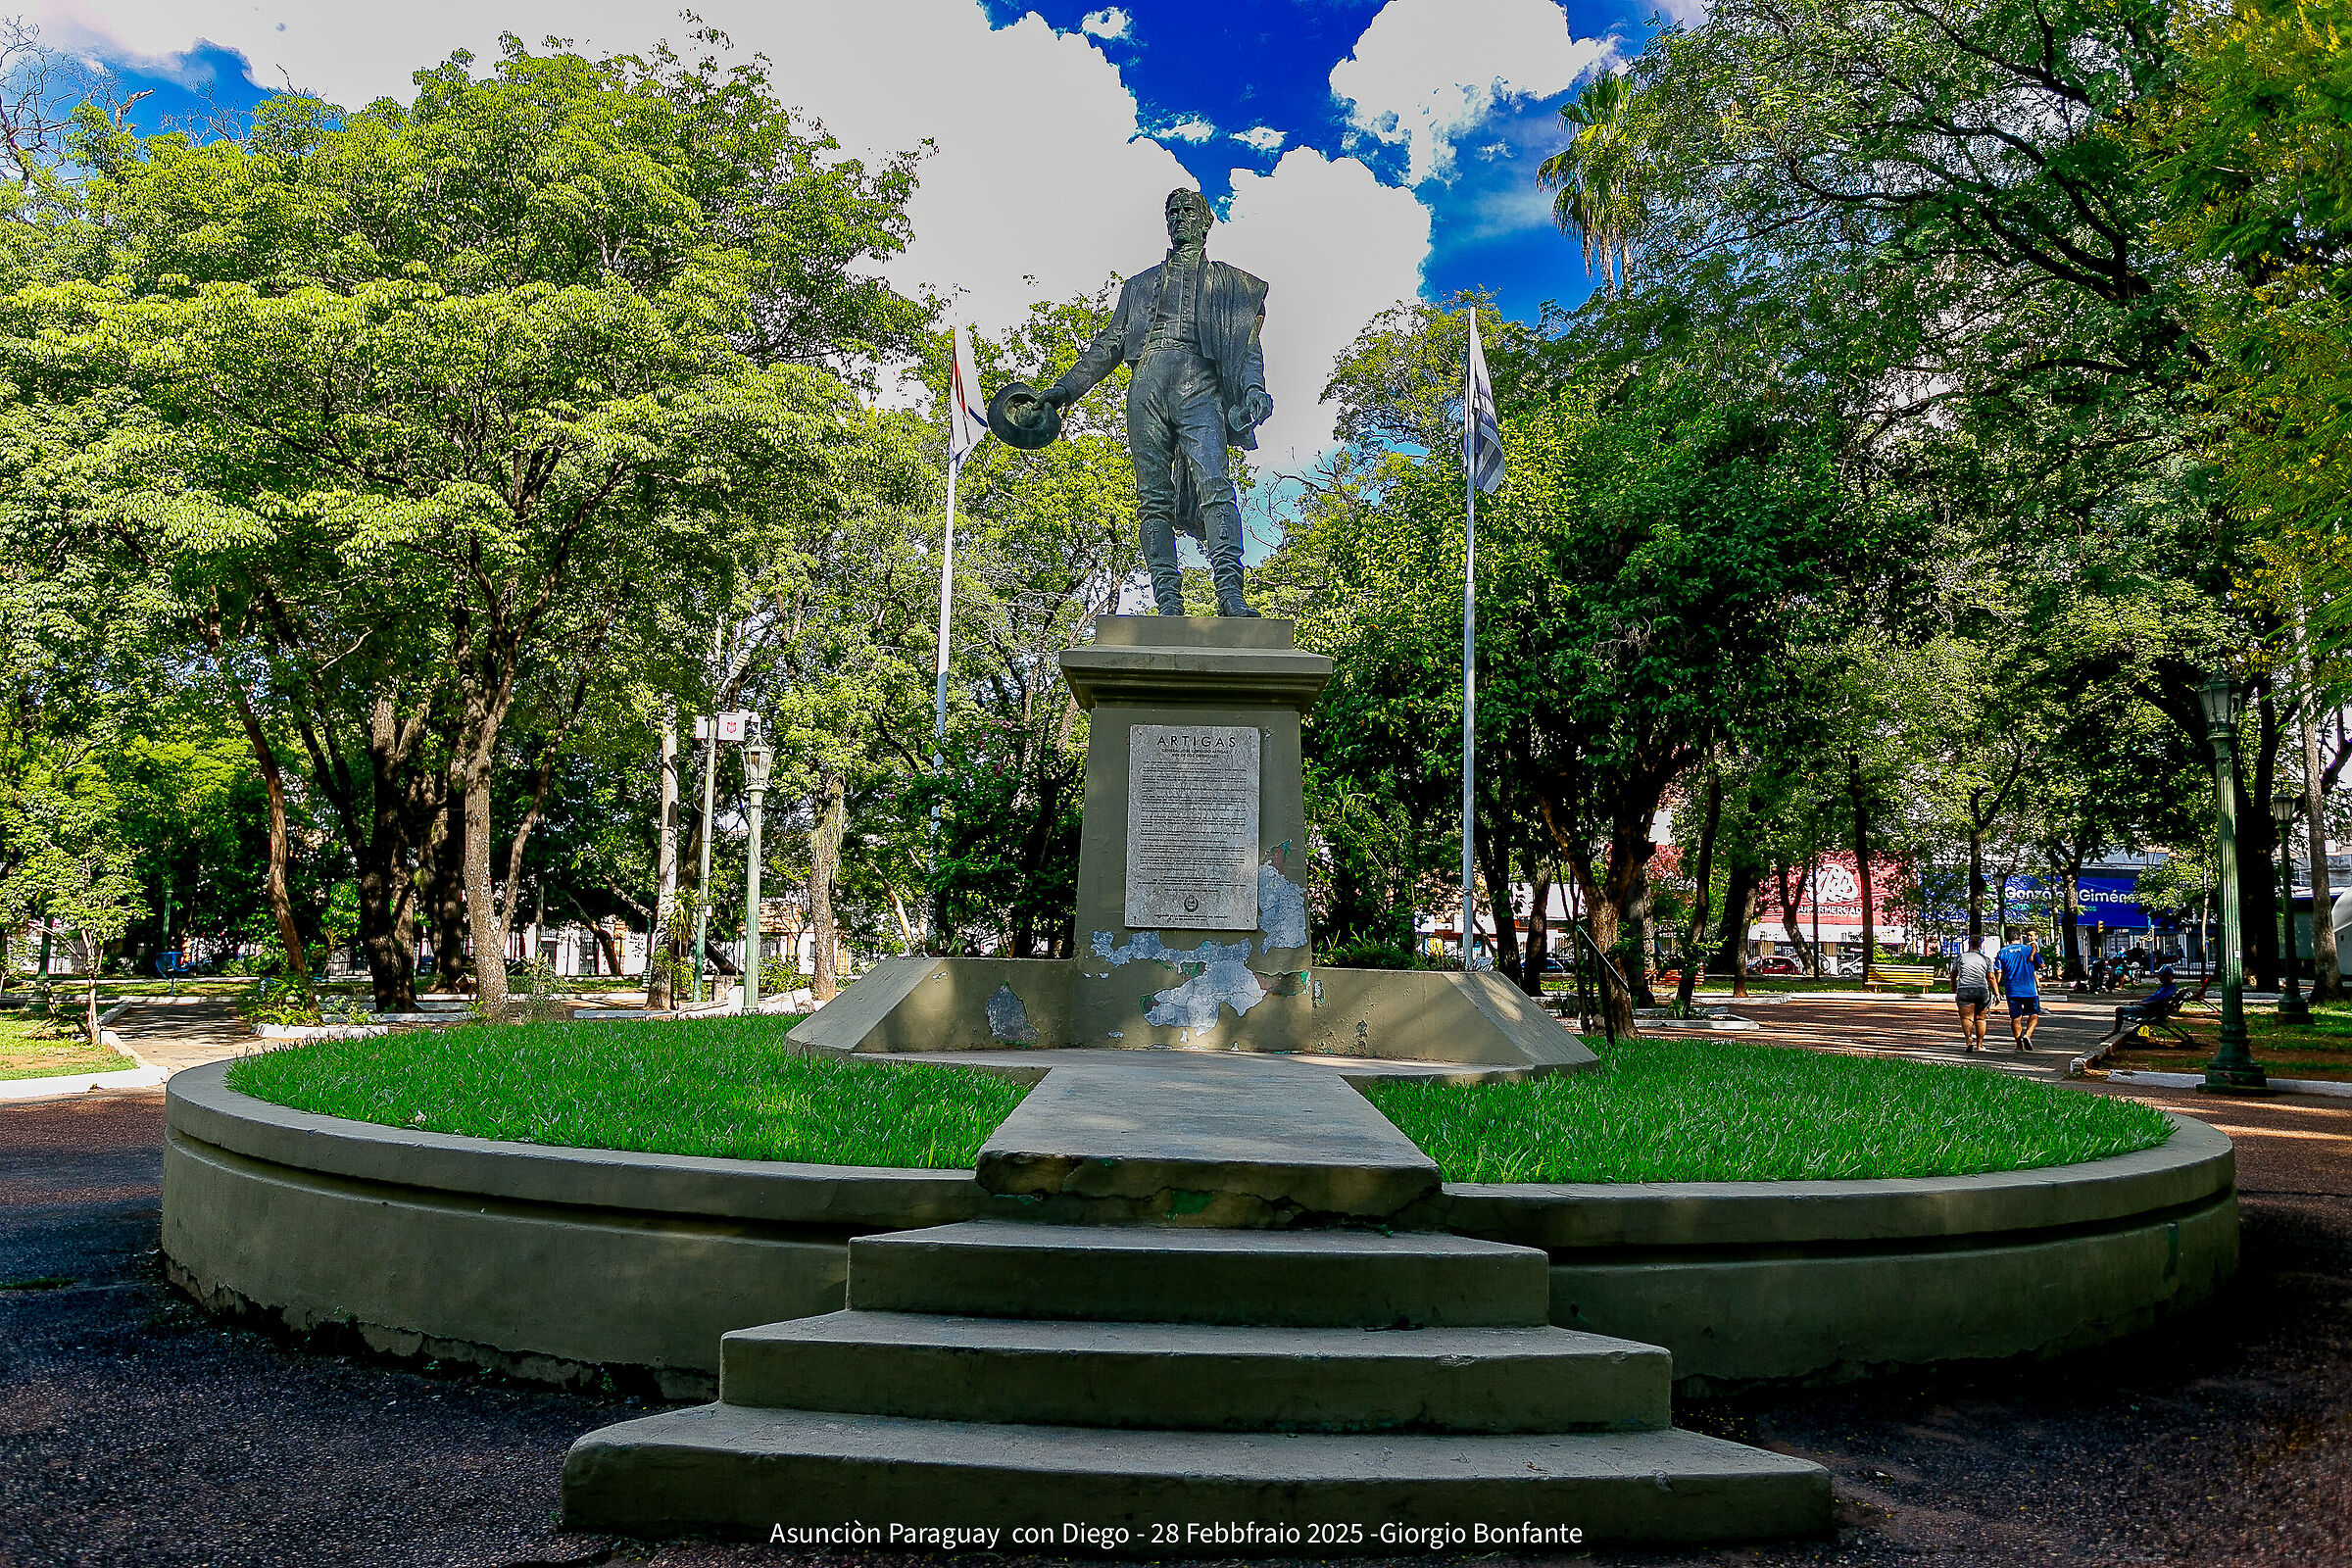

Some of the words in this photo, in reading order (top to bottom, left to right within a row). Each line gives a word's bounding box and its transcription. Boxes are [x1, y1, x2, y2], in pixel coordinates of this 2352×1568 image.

[1156, 735, 1237, 748] ARTIGAS
[2004, 886, 2068, 901] Gonzáe
[2079, 888, 2141, 904] Gimén
[1797, 906, 1864, 915] SUPRMERCAD
